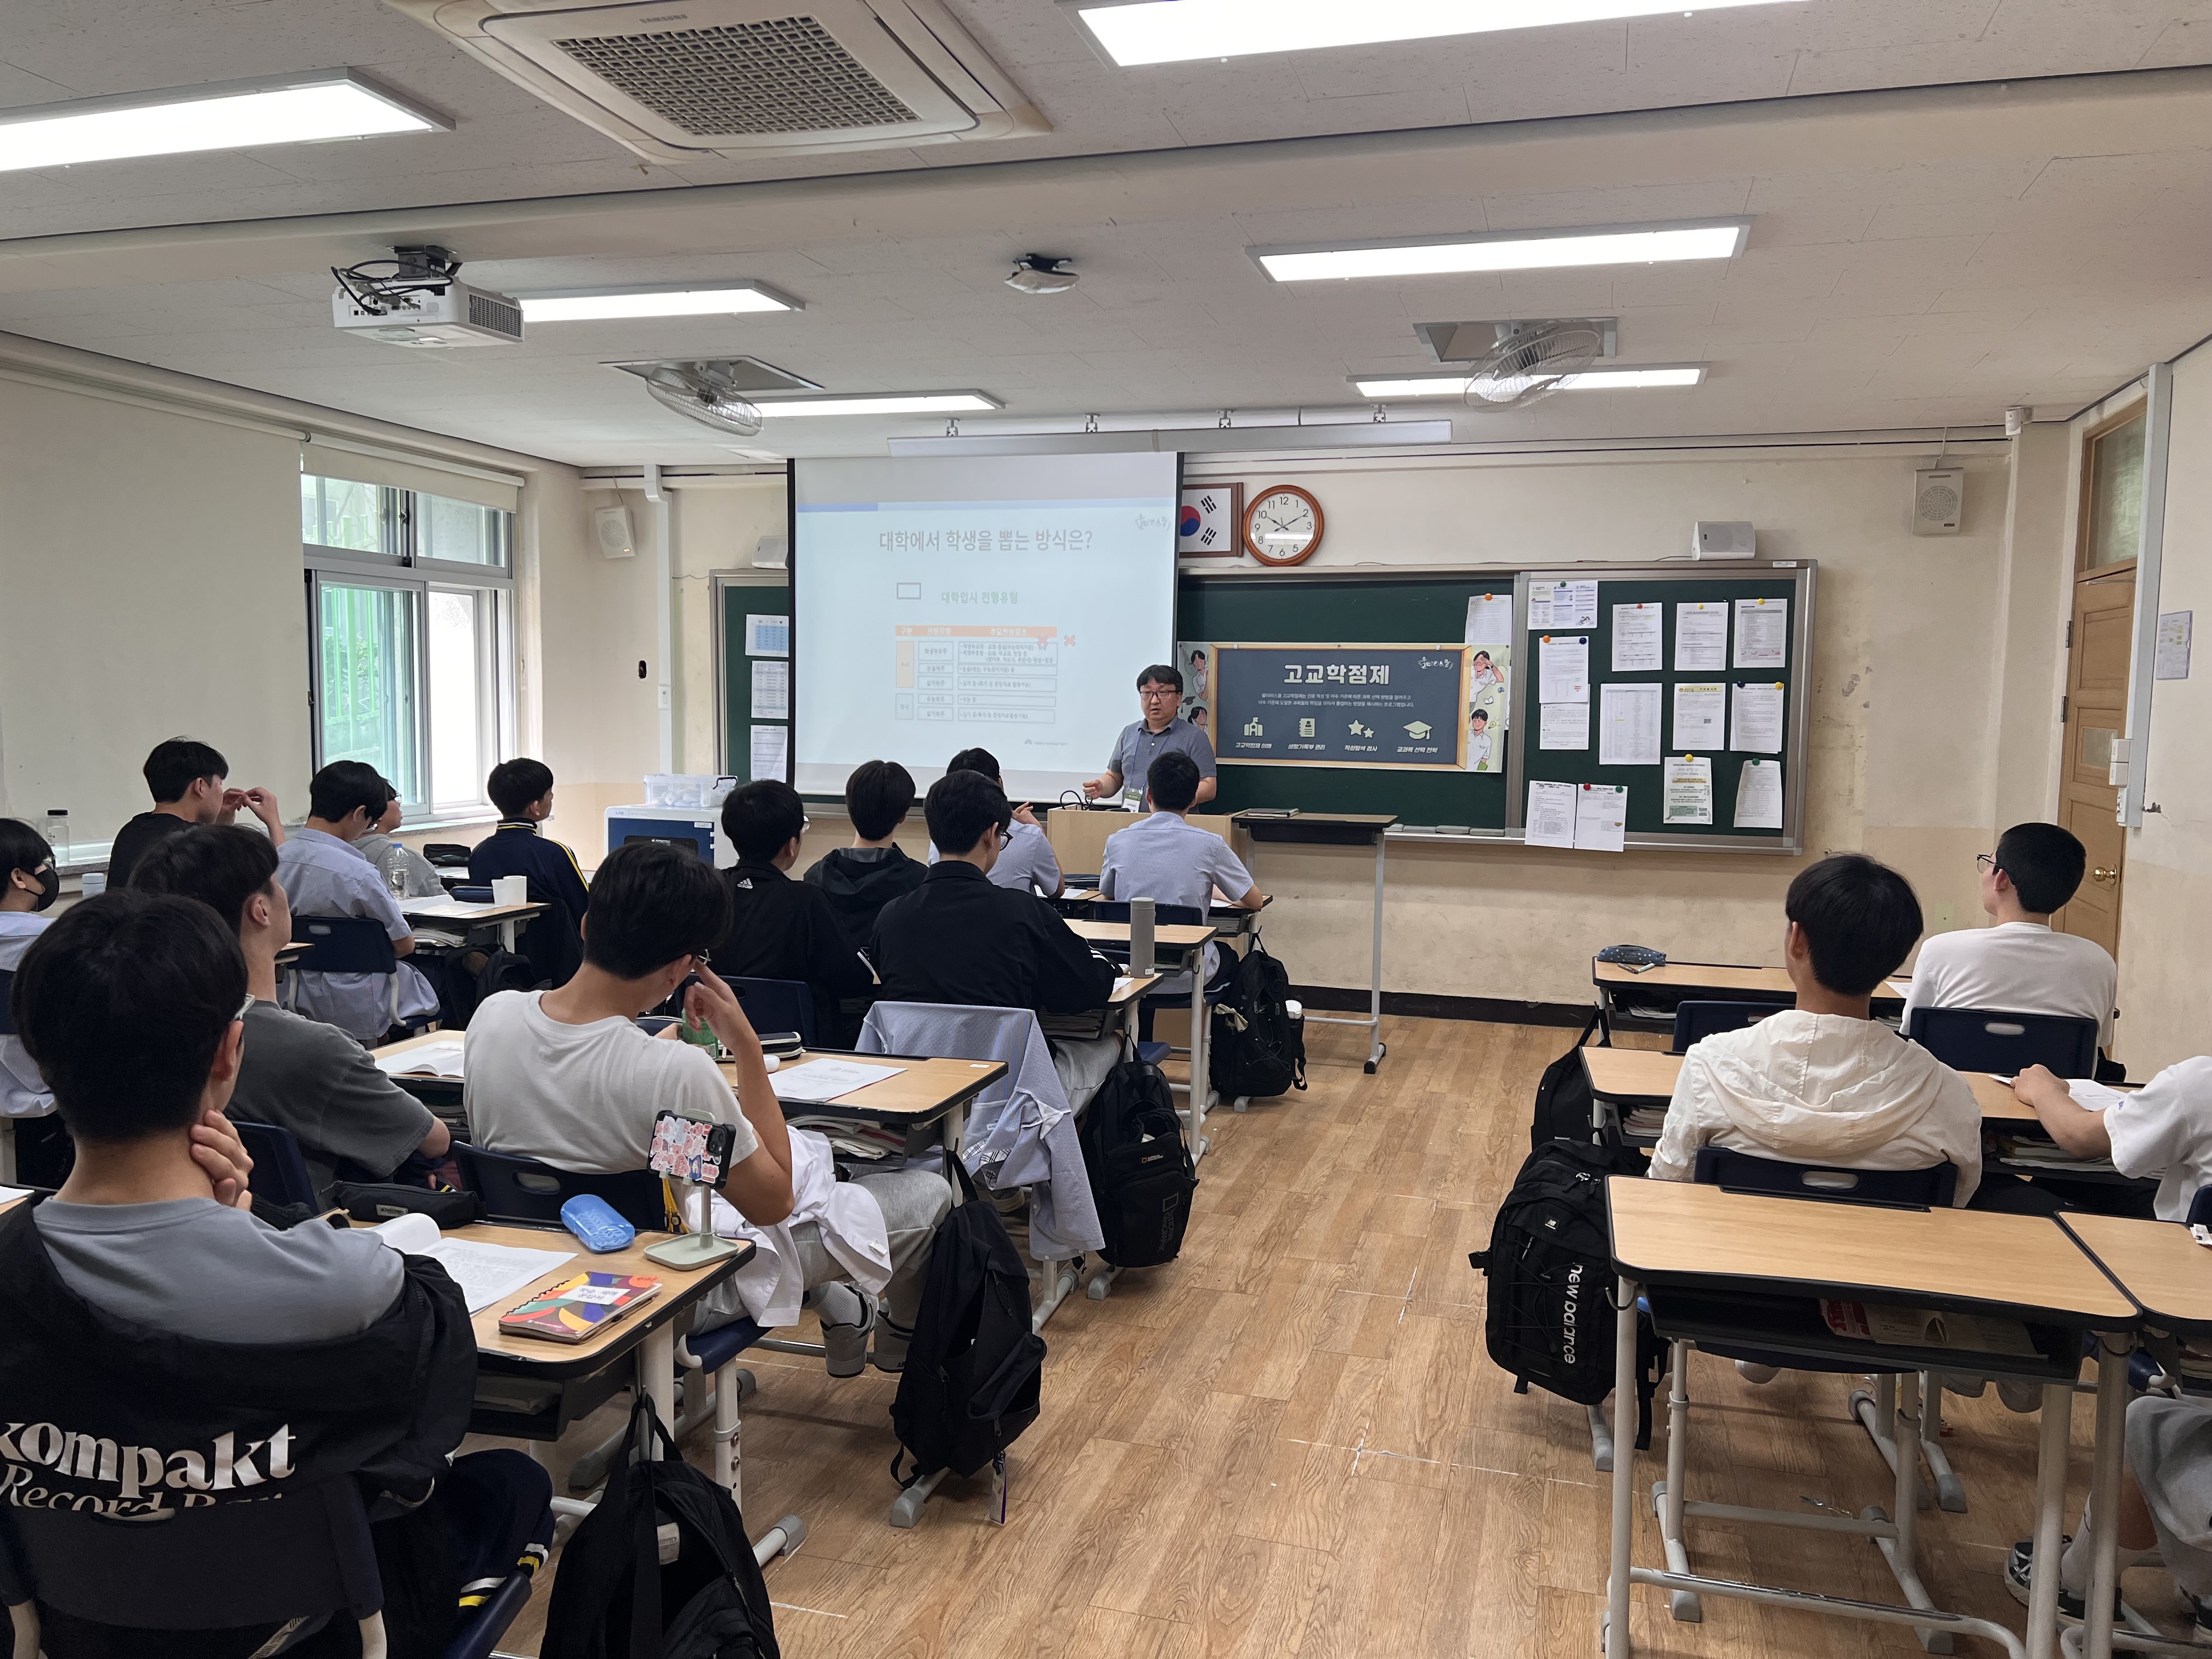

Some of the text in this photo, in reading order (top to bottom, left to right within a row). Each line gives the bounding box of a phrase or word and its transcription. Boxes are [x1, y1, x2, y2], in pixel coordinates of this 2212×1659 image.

[1268, 500, 1275, 509] 11
[1279, 496, 1289, 505] 12
[1295, 500, 1299, 508] 1
[1258, 510, 1267, 519] 10
[1303, 509, 1309, 517] 2
[1254, 523, 1261, 532] 9
[1306, 521, 1312, 530] 3
[879, 529, 1092, 552] 대학에서 학생을 뽑는 방식은?
[1258, 536, 1263, 544] 8
[1268, 545, 1273, 553] 7
[1279, 548, 1285, 556] 6
[1293, 544, 1299, 552] 5
[941, 591, 1018, 604] 대학입시 전형유형
[1284, 664, 1390, 685] 고교학점제
[1563, 1262, 1583, 1364] new balance
